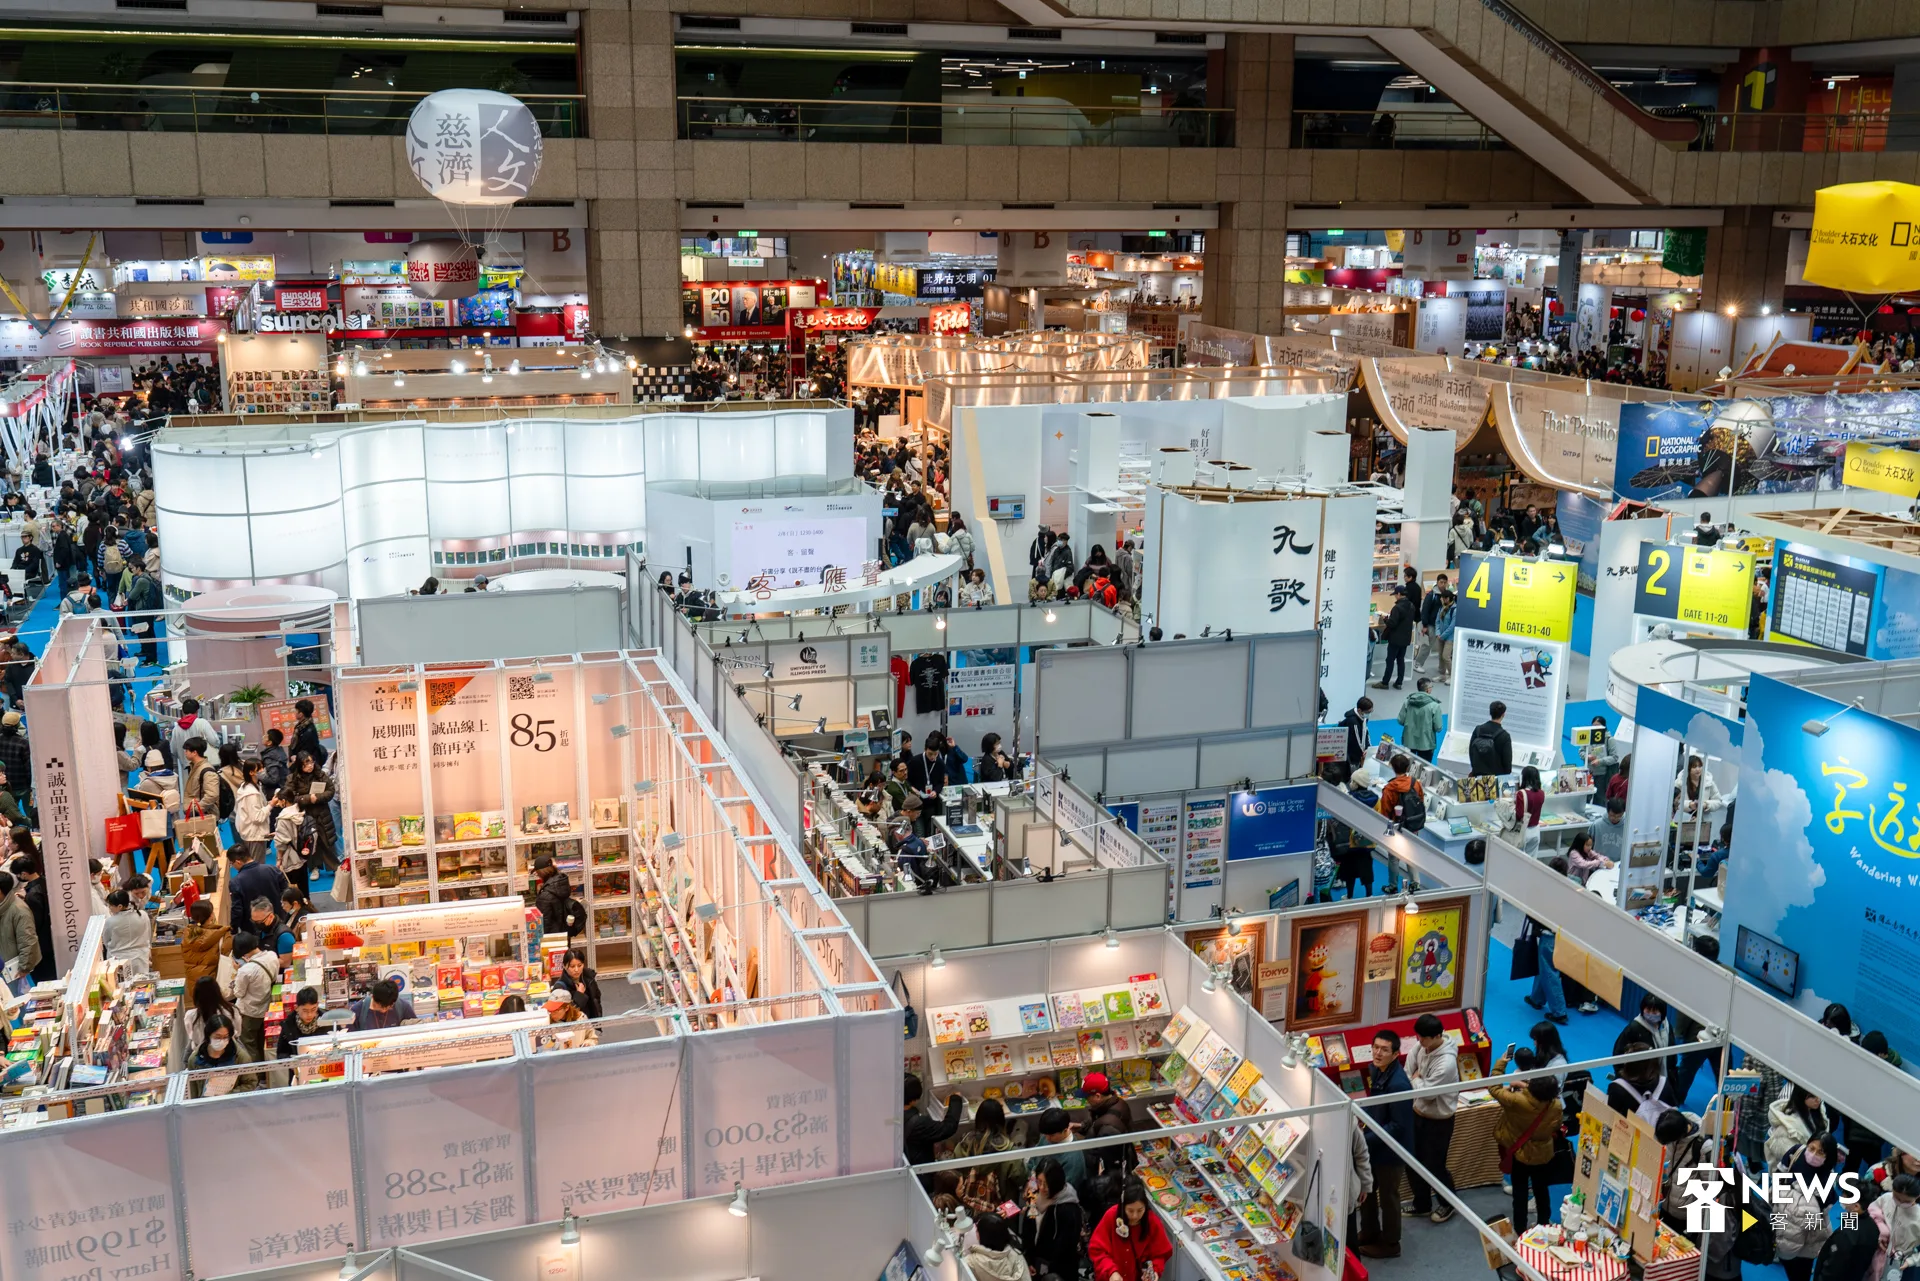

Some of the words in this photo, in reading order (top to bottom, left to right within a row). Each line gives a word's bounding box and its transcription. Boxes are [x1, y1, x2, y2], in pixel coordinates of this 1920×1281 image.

[434, 112, 473, 187] 慈濟
[480, 109, 530, 193] 人文
[1840, 231, 1879, 247] 大石文化
[922, 273, 977, 285] 世界古文明
[281, 290, 321, 299] suncolor
[282, 298, 322, 308] 三采文化
[711, 289, 730, 304] 20
[129, 299, 194, 312] 共和國沙龍
[260, 308, 371, 332] suncolor
[711, 309, 730, 327] 50
[80, 326, 199, 341] 讀書共和國出版集團
[137, 340, 175, 348] PUBLISHING
[1540, 409, 1569, 433] Thai
[1659, 444, 1702, 455] GEOGRAPHIC
[1660, 436, 1694, 446] NATIONAL
[1658, 457, 1691, 468] 國家地理
[1885, 464, 1915, 483] 大石文化
[1267, 524, 1315, 613] 九歌
[1645, 549, 1671, 596] 2
[1465, 562, 1492, 609] 4
[1683, 608, 1703, 621] GATE
[1705, 610, 1728, 625] 11-20
[1506, 621, 1525, 634] GATE
[1527, 623, 1551, 637] 31-40
[369, 696, 413, 712] 電子書
[371, 723, 416, 740] 展期間
[431, 719, 490, 736] 誠品線上
[510, 712, 557, 752] 85
[1594, 730, 1603, 742] 3
[372, 743, 417, 760] 電子書
[432, 740, 476, 756] 館再享
[47, 772, 71, 839] 誠品書店
[56, 841, 71, 881] eslite
[1849, 845, 1902, 888] Wandering
[61, 881, 79, 953] bookstore
[1260, 967, 1289, 979] TOKYO
[1723, 1083, 1748, 1092] D509
